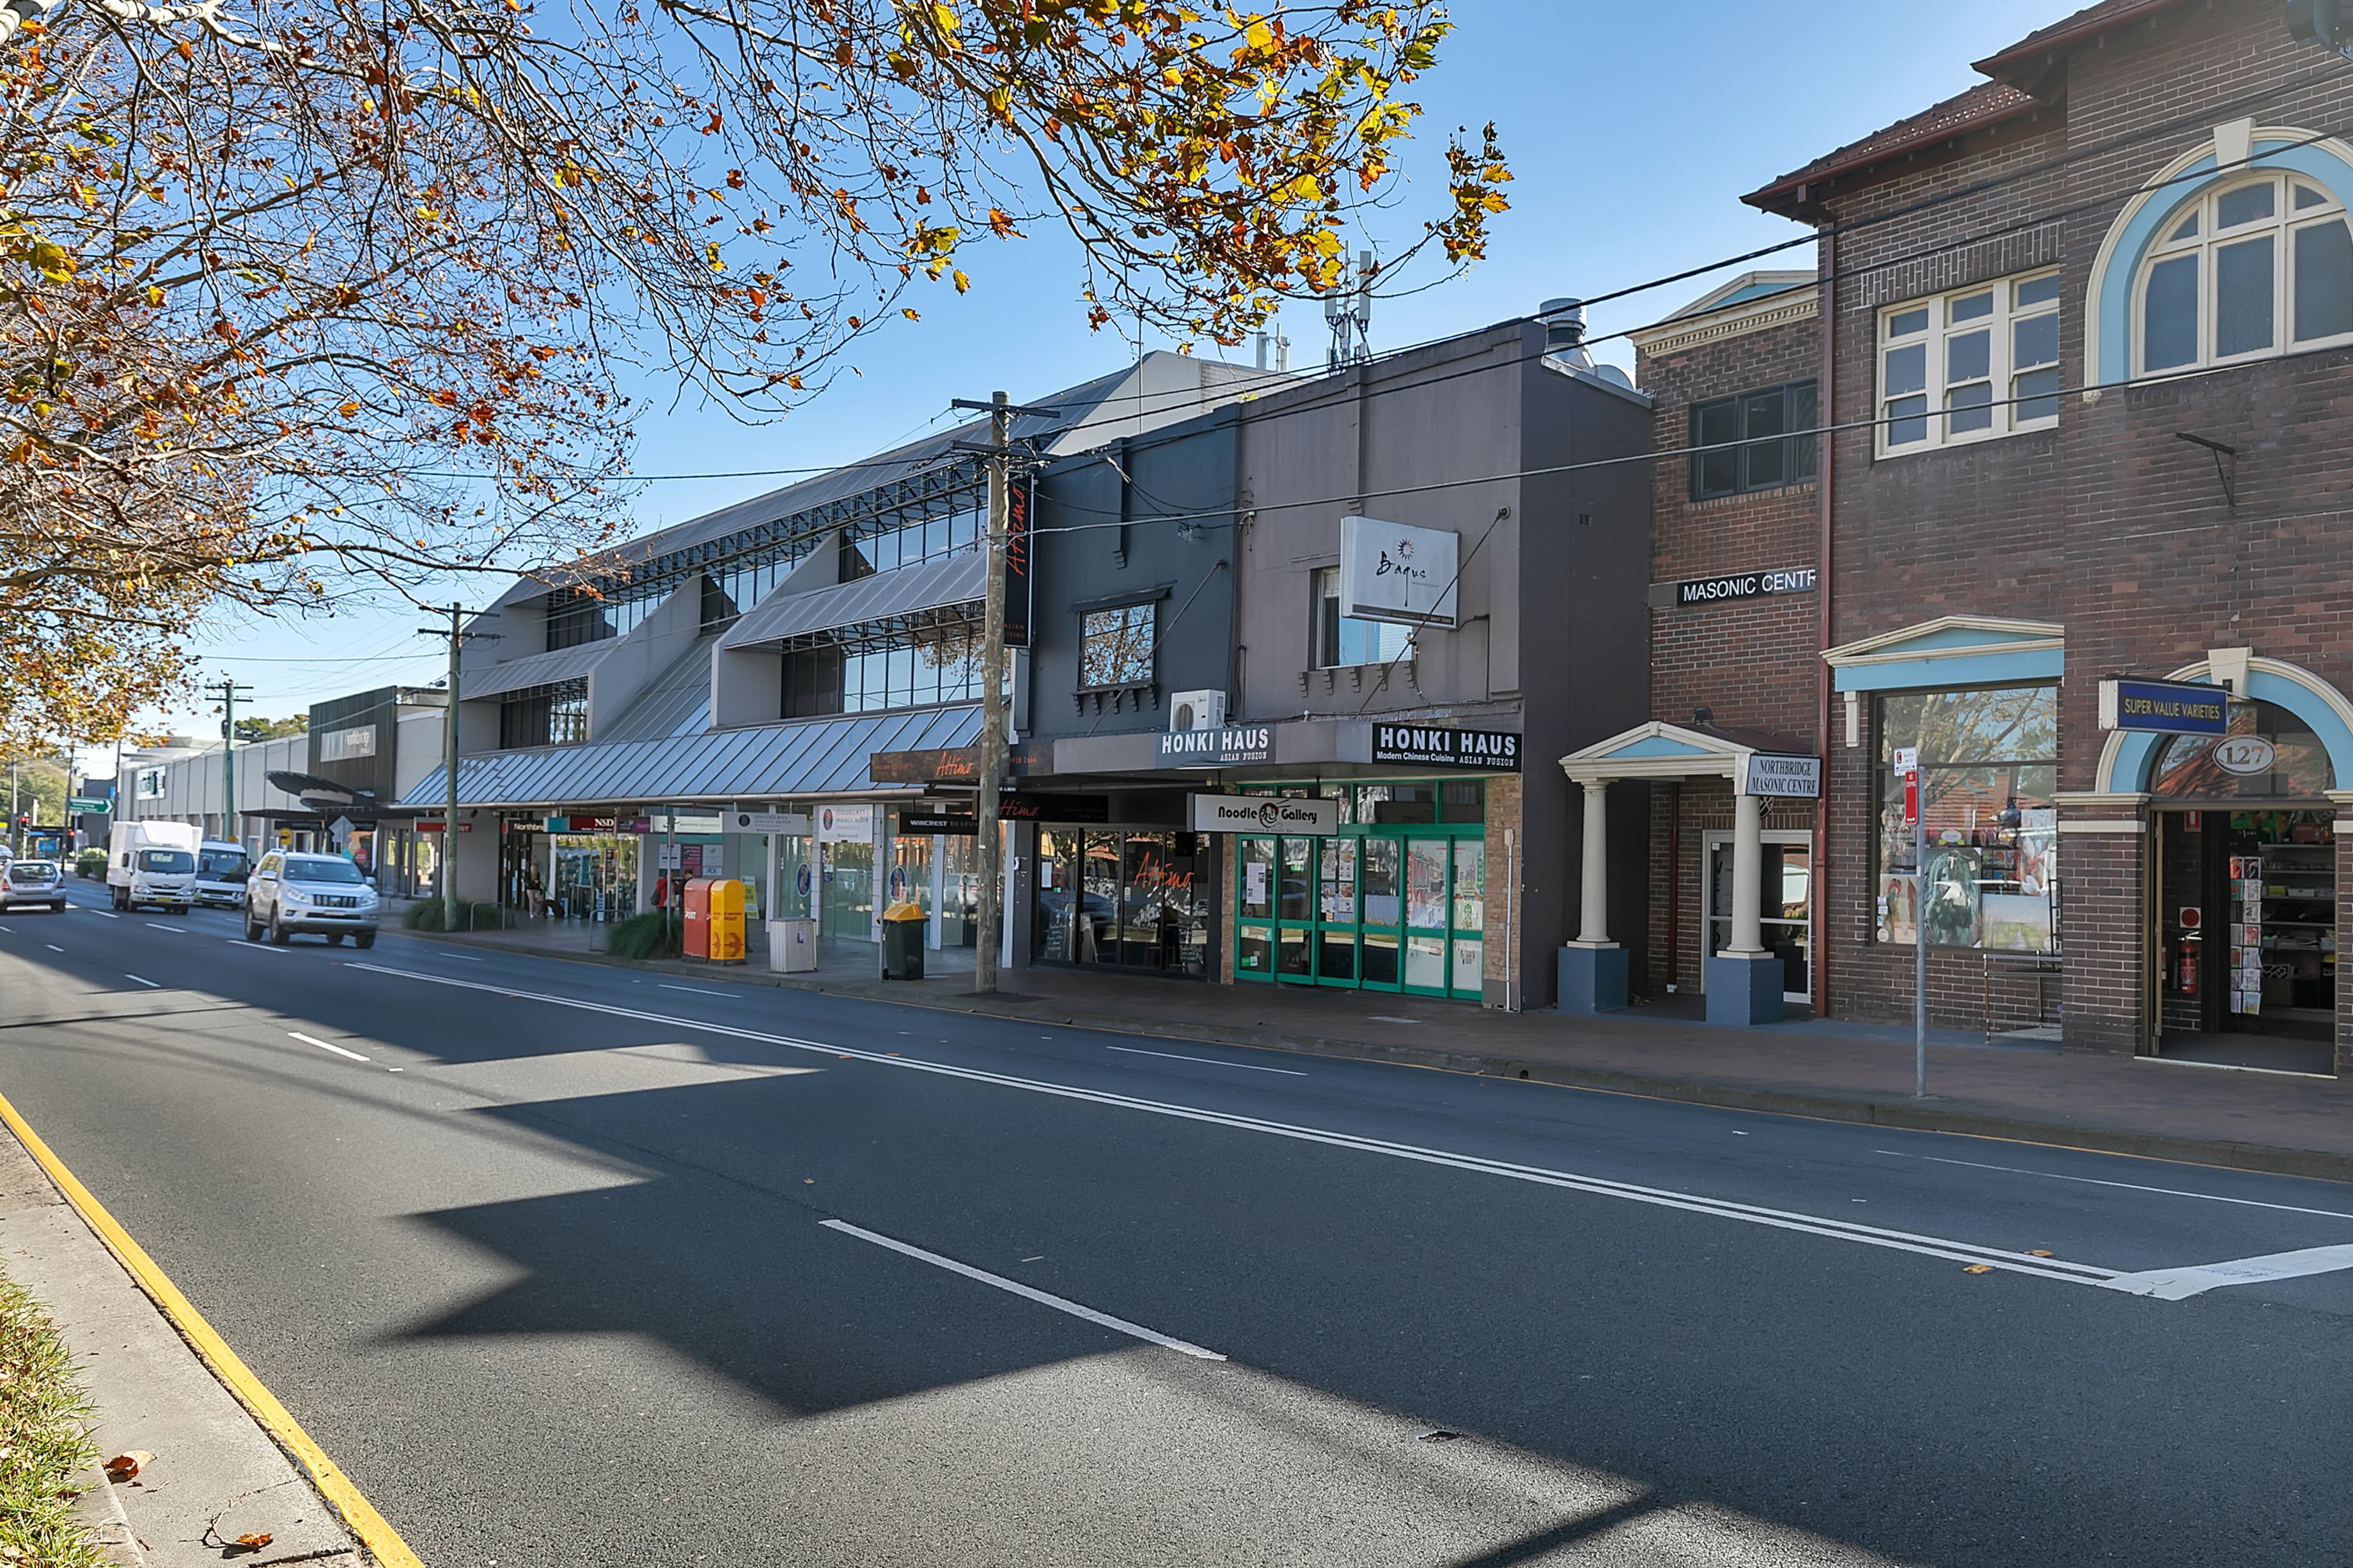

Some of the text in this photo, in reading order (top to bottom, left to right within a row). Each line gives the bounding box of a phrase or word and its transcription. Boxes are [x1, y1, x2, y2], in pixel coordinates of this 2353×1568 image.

[1376, 550, 1426, 607] Bagus
[1684, 569, 1816, 602] MASONIC CENTR
[2124, 698, 2220, 720] SUPER VALUE VARIETIES
[1162, 728, 1269, 754] HONKI HAUS
[1380, 727, 1515, 756] HONKI HAUS
[935, 751, 972, 777] Attimo
[1242, 751, 1267, 761] FUSION
[1377, 751, 1455, 763] Modern Chinese Cuisine
[1459, 756, 1515, 766] ASIAN FUSION
[2225, 745, 2265, 765] 127
[1760, 759, 1811, 776] NORTHBRIDGE
[1752, 777, 1817, 793] MASONIC CENTRE
[999, 799, 1041, 816] ttimo
[1218, 805, 1317, 825] Noodle Gallery
[595, 818, 614, 827] NSD
[1133, 851, 1194, 889] Attimo
